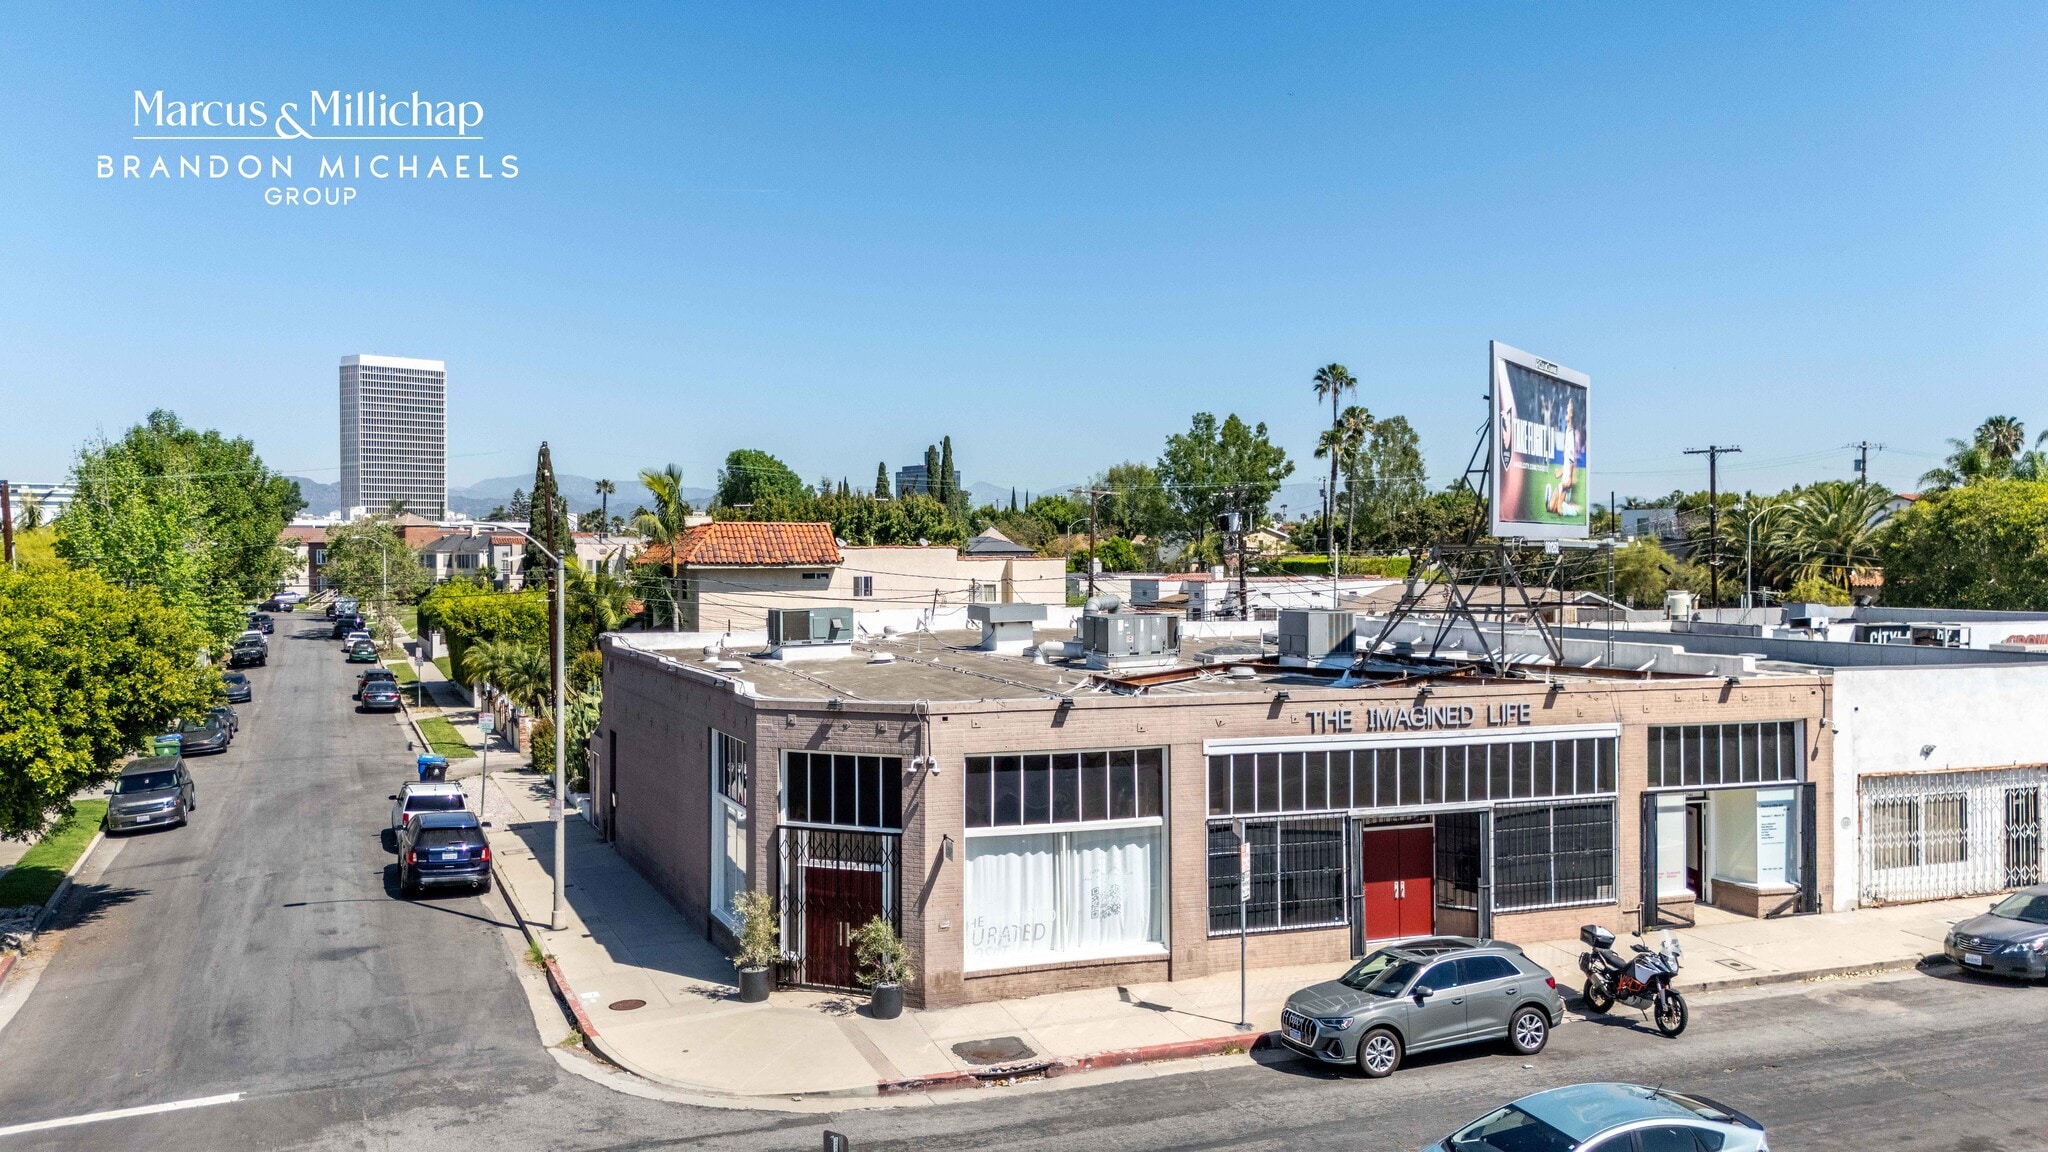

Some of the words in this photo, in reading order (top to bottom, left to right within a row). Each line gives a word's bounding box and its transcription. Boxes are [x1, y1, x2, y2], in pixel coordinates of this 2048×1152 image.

[1309, 709, 1352, 730] THE
[1368, 704, 1475, 728] IMAGINED
[1487, 703, 1531, 723] LIFE
